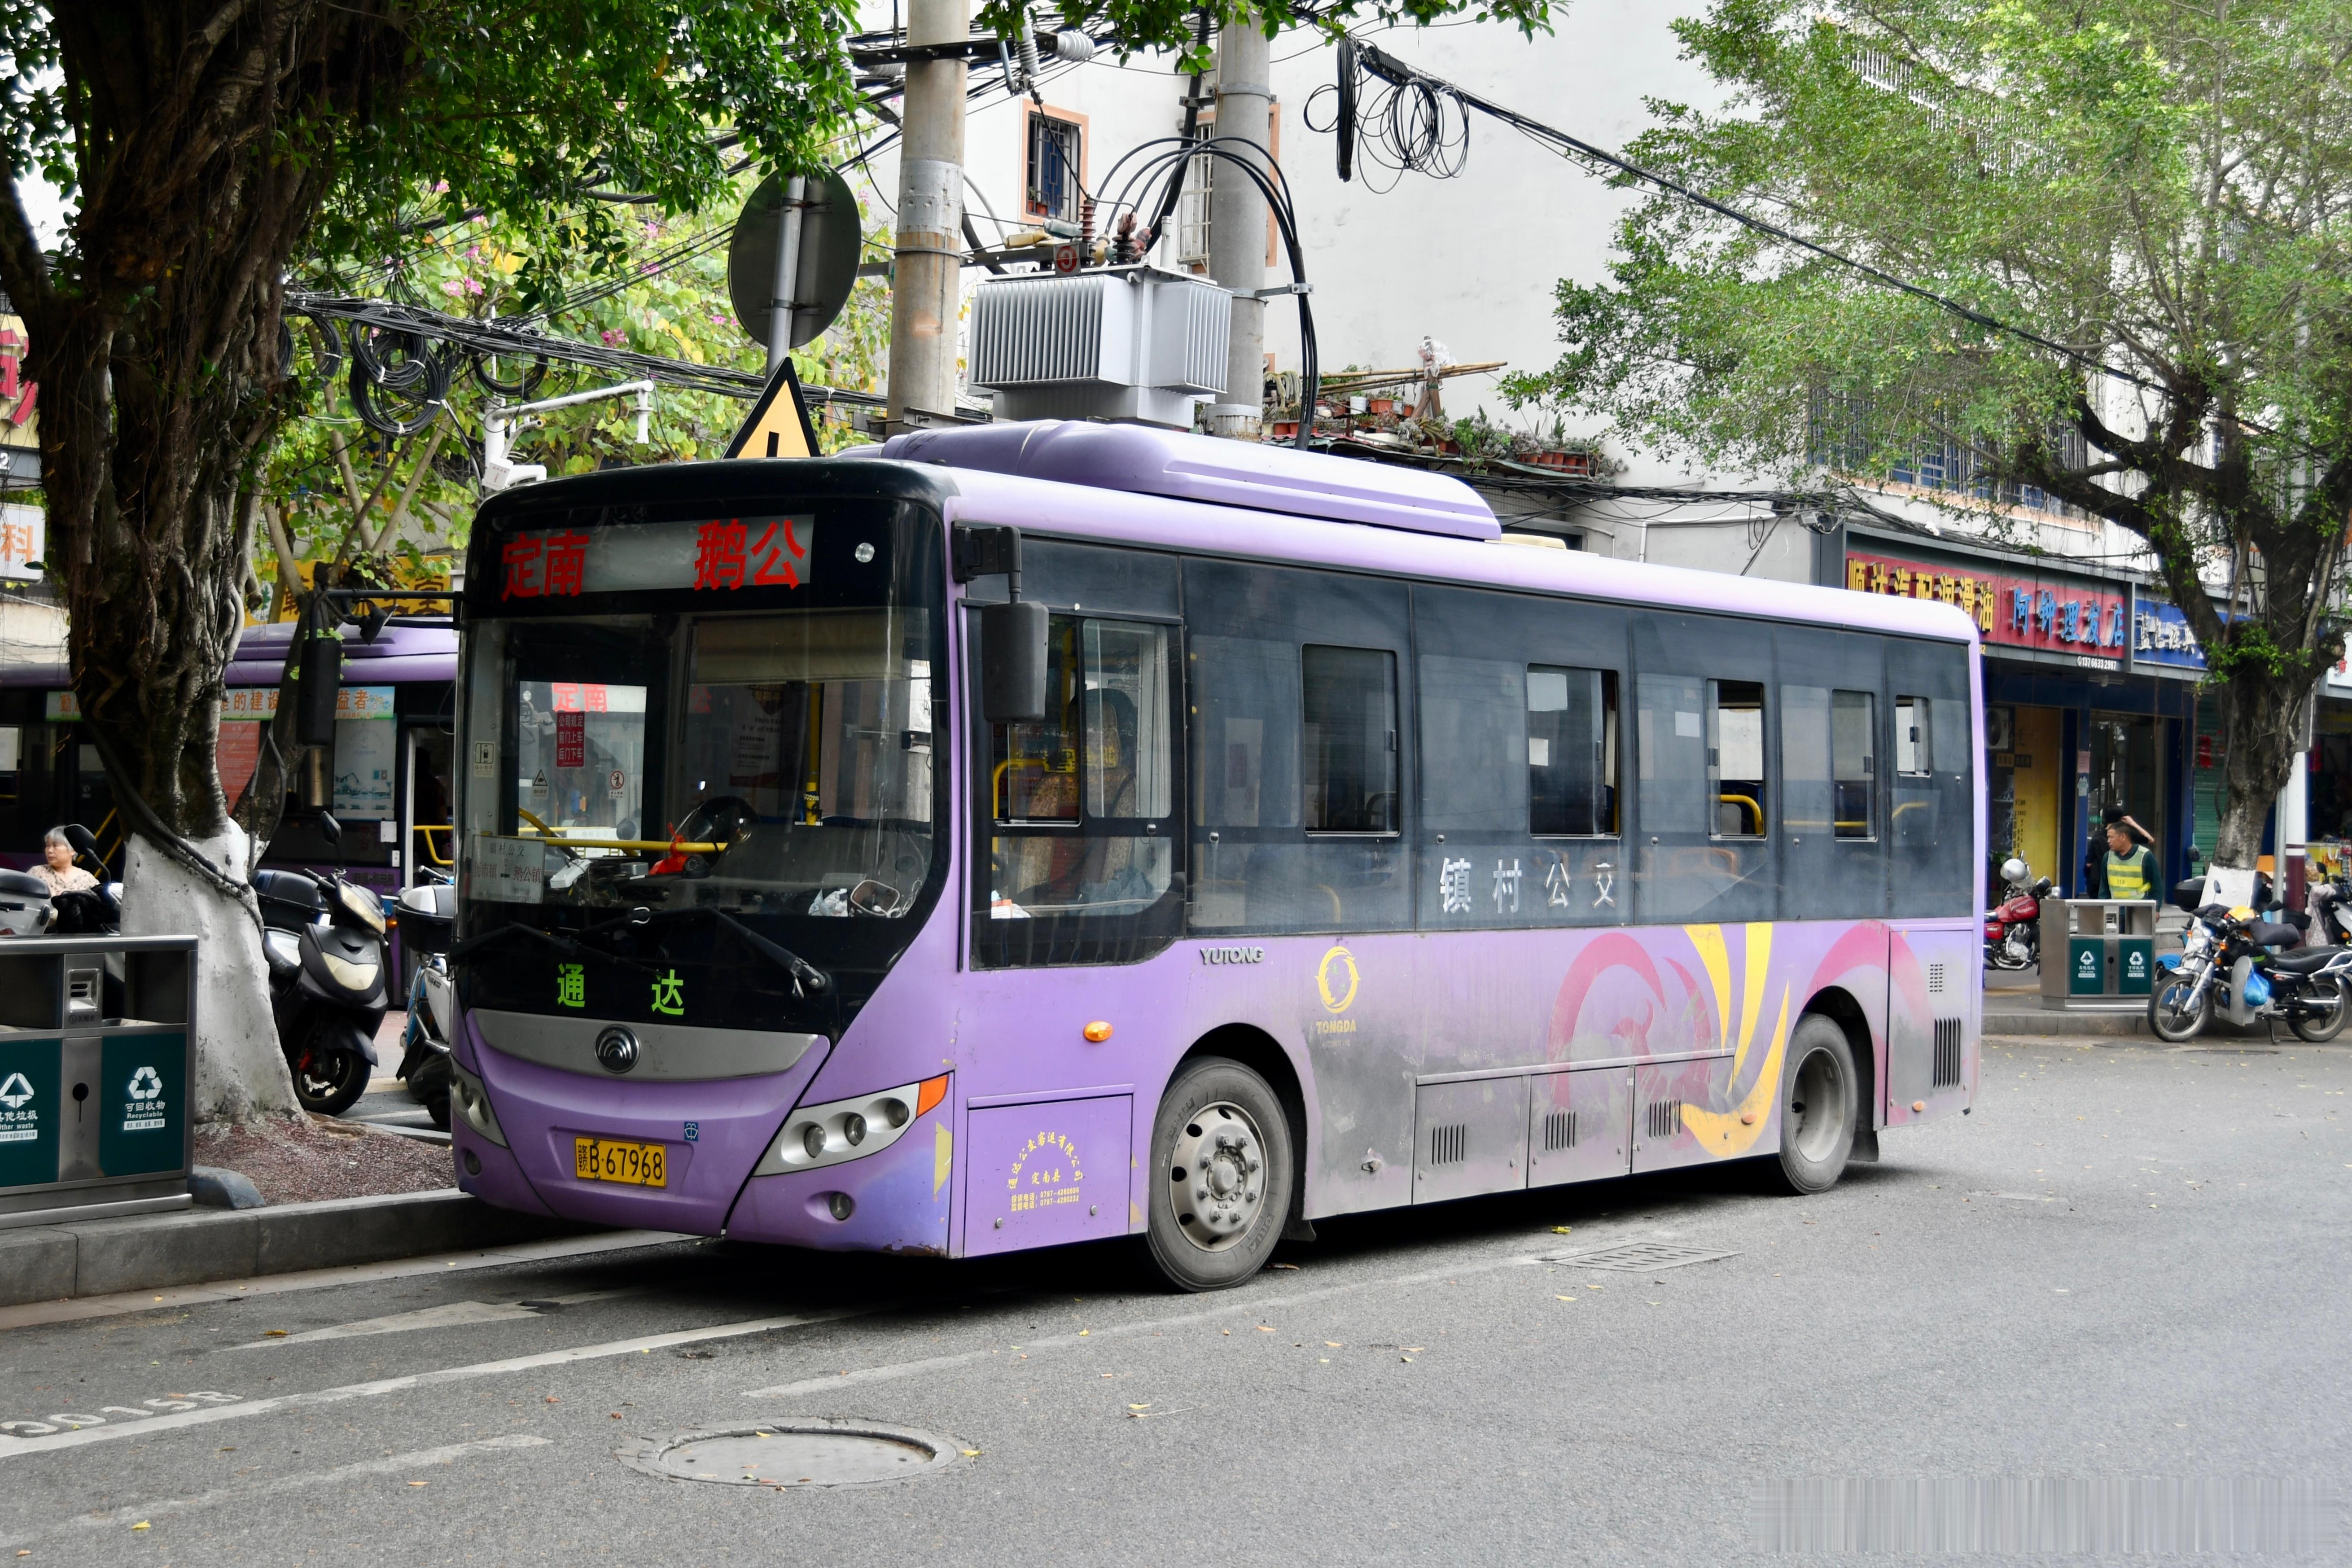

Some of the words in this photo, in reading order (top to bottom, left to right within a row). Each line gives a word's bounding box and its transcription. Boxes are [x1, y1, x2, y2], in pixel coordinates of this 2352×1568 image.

[500, 530, 589, 602] 定南
[694, 518, 806, 590] 鹅公
[2012, 587, 2124, 647] 阿钟理发店
[559, 714, 583, 727] 公司规定
[559, 730, 583, 744] 前门上车
[559, 747, 583, 760] 后门下车
[1440, 858, 1616, 914] 镇村公交
[1200, 946, 1265, 965] YUTONG
[1316, 1020, 1356, 1034] TONGDA
[125, 1100, 166, 1112] 可回收物
[127, 1111, 163, 1119] Recyclable
[1031, 1168, 1060, 1185] 定南县
